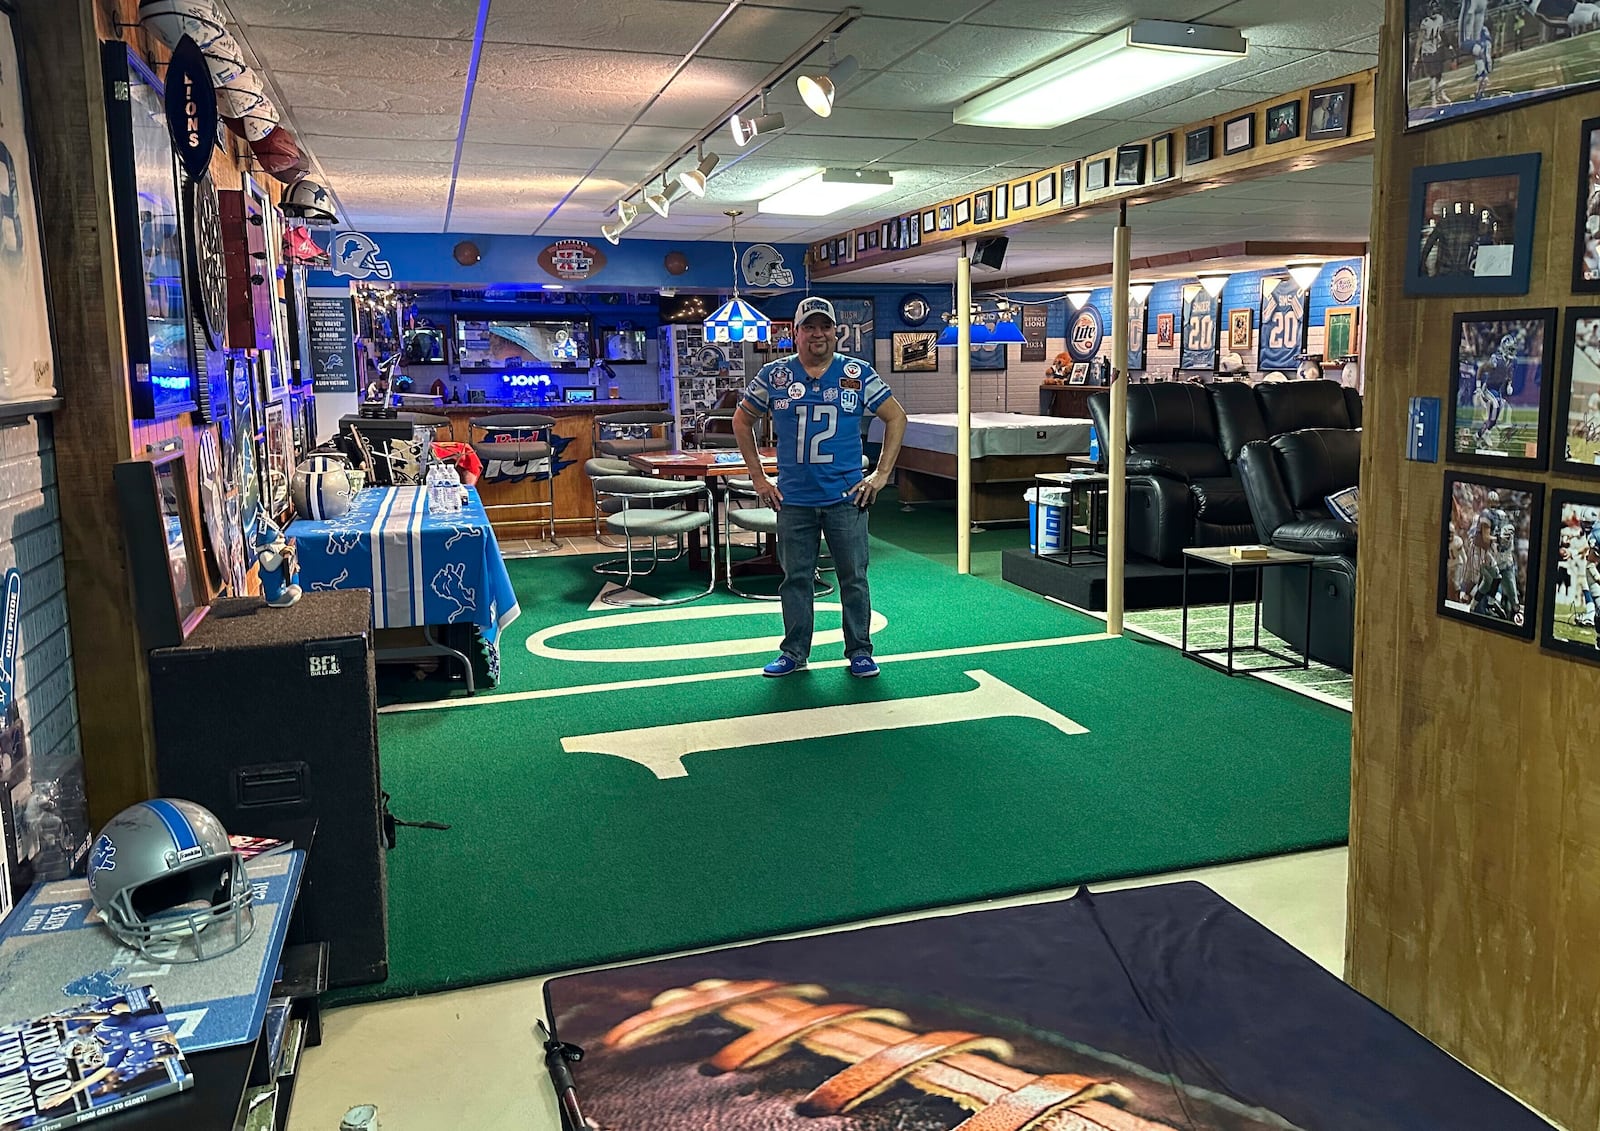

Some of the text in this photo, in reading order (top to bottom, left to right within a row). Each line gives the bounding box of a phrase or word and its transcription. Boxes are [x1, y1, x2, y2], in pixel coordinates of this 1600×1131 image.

[184, 71, 199, 147] LIONS
[837, 324, 861, 352] 21
[1073, 325, 1097, 343] Lite
[1189, 316, 1213, 350] 20
[1270, 311, 1298, 348] 20
[795, 404, 838, 464] 12
[5, 592, 18, 658] ONE PRIDE
[76, 1094, 148, 1122] FROM GRIT TO GLORY!
